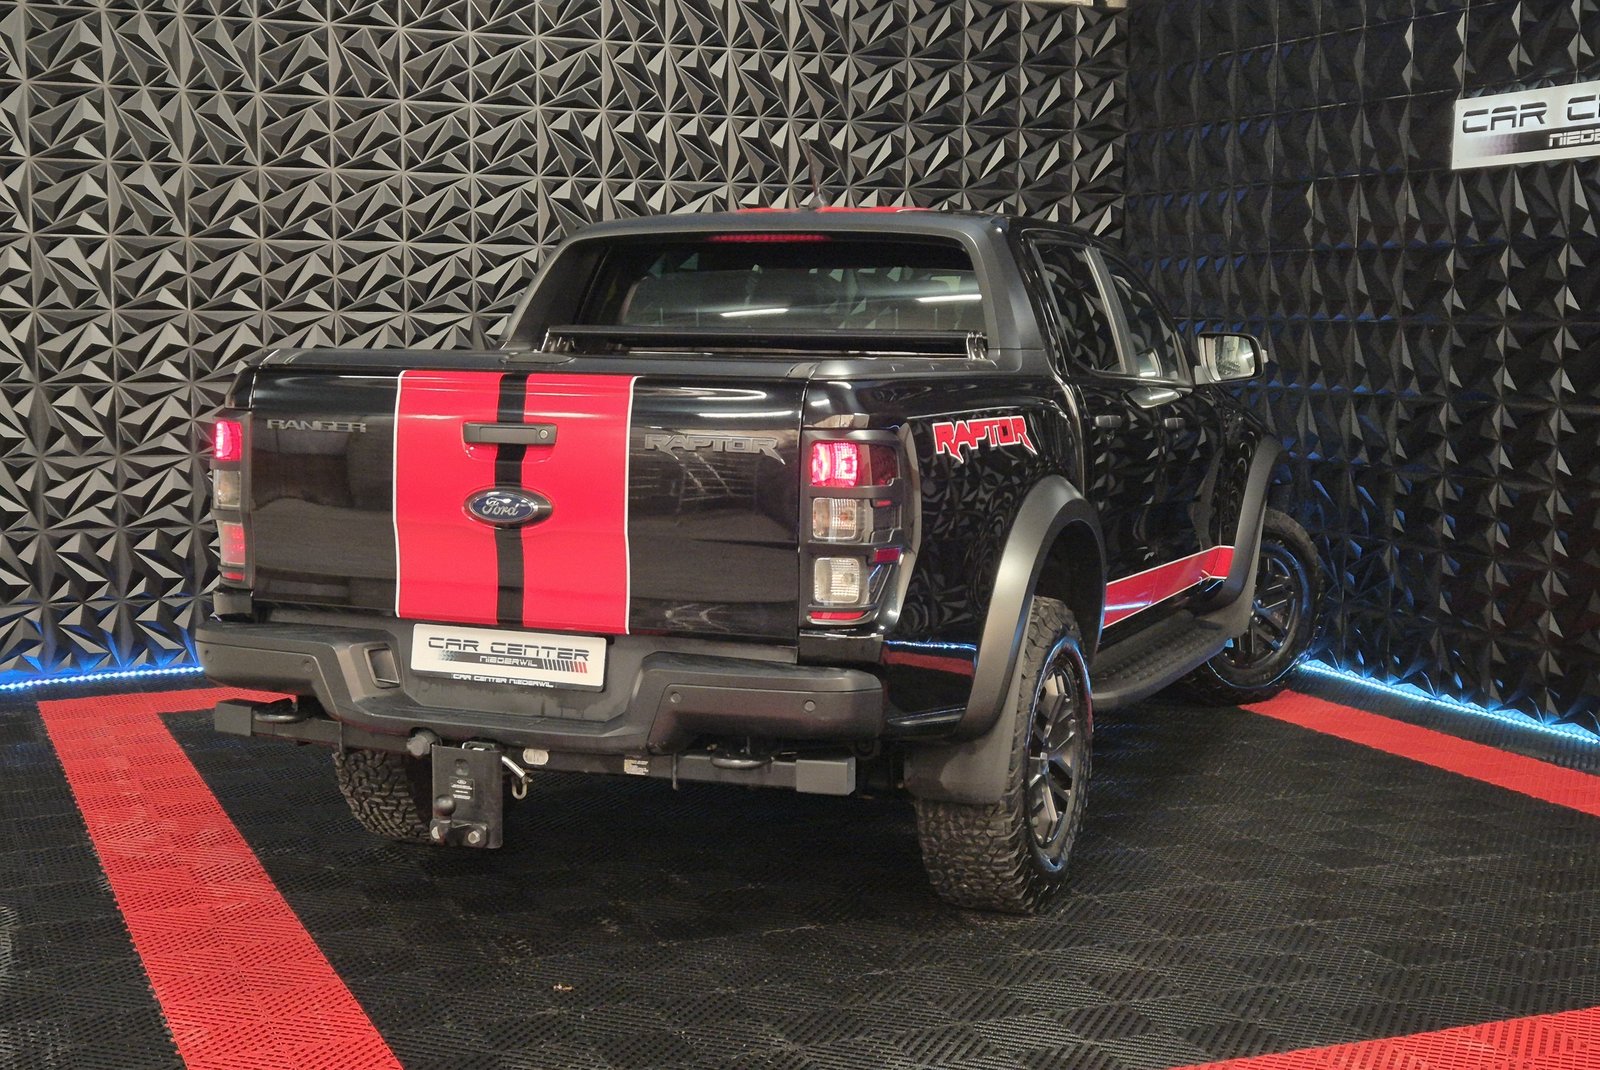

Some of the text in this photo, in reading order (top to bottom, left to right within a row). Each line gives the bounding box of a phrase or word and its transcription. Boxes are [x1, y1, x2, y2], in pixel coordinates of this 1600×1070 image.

[1462, 94, 1600, 133] CAR C
[266, 419, 367, 433] RANGER
[644, 433, 786, 465] RAPTOR
[932, 415, 1038, 464] RAPTOR
[482, 497, 519, 516] Ford
[428, 636, 590, 662] CAR CENTER
[479, 655, 538, 668] NIEDERWIL
[452, 673, 554, 689] CAR CENTER NIEDERWIL
